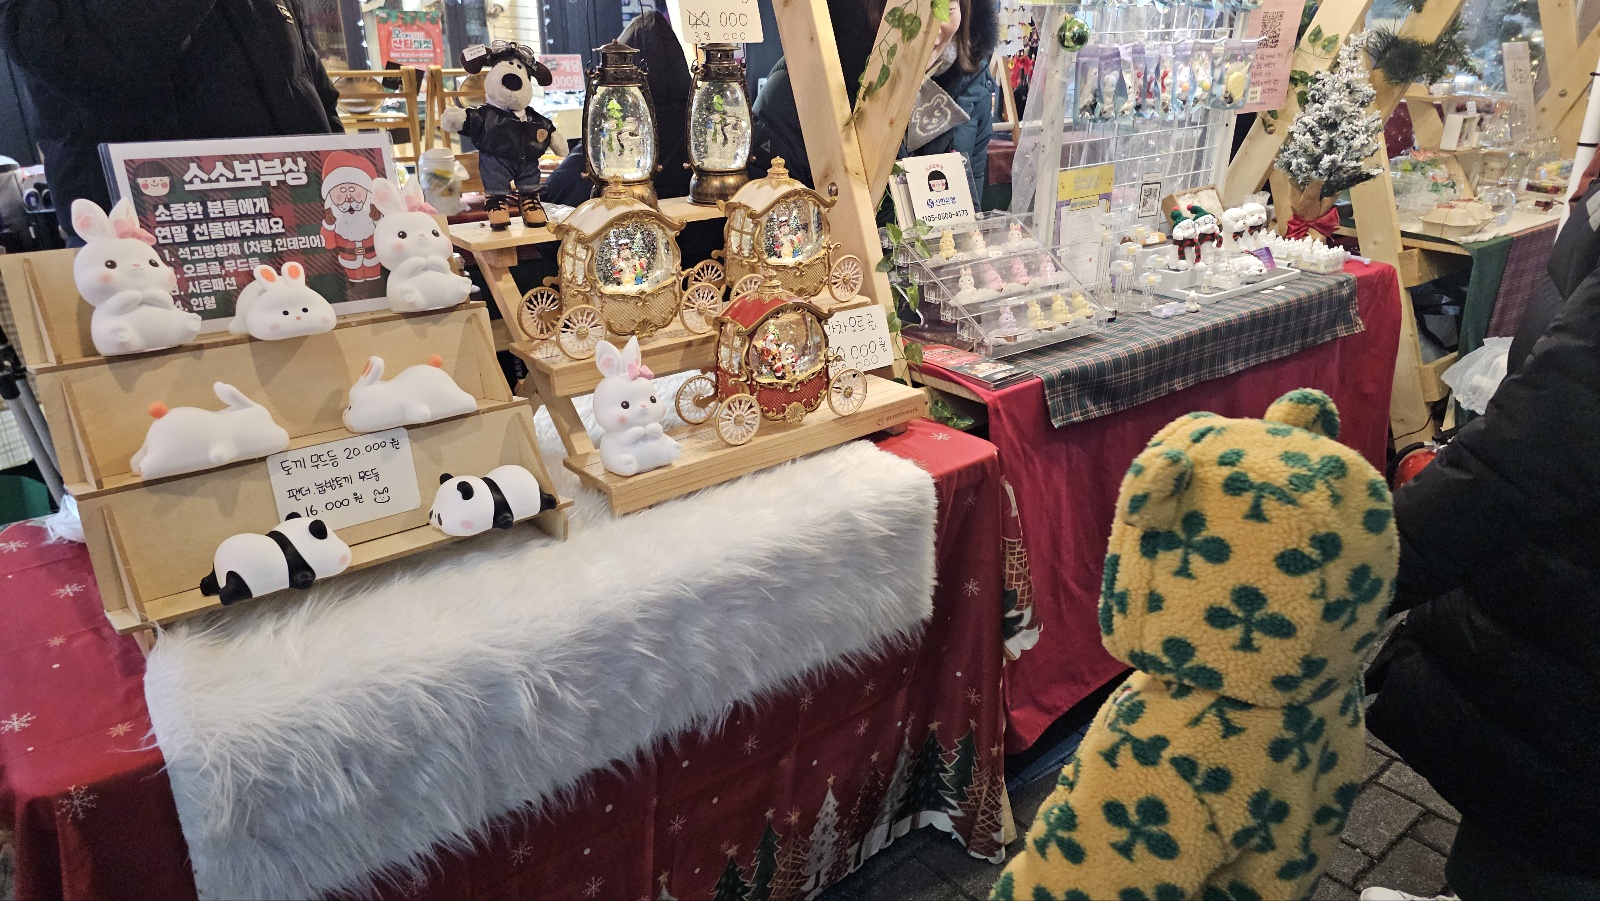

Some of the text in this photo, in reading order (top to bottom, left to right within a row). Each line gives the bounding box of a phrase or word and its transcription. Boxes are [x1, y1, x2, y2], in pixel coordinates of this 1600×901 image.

[559, 59, 580, 73] 개당
[183, 157, 308, 191] 소소보부상
[154, 197, 270, 222] 소중한 분들에게
[154, 217, 285, 244] 연말 선물해주세요
[163, 234, 325, 261] 1. 석고방향제 (차량,인테리어)
[188, 277, 237, 294] 시즌패션
[190, 296, 217, 311] 인형
[280, 457, 307, 475] 토끼
[310, 450, 339, 469] 무드등
[389, 437, 400, 450] 원
[358, 468, 380, 482] 무드등
[353, 492, 364, 504] 원
